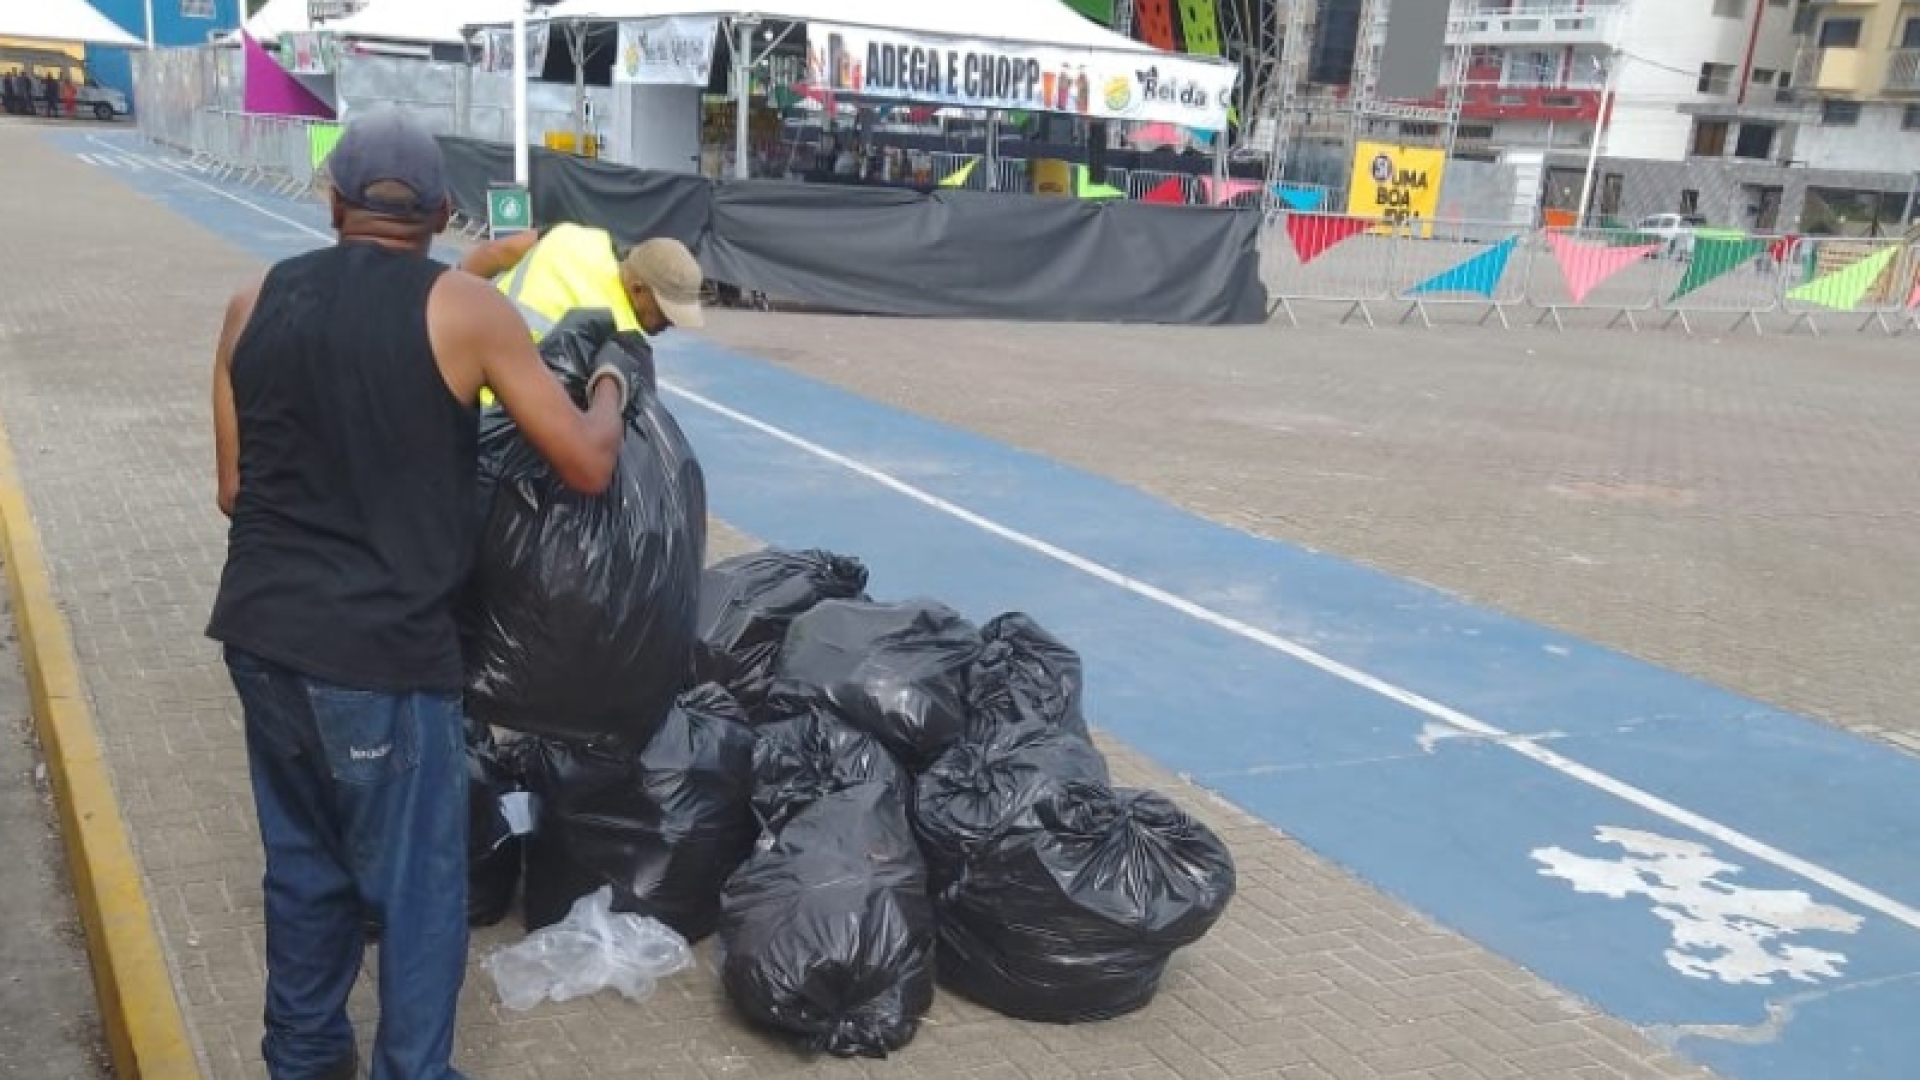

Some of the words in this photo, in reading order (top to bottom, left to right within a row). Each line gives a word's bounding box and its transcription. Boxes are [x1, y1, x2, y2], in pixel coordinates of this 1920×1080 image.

[866, 41, 941, 94] ADEGA
[947, 50, 958, 96] E
[964, 52, 1040, 100] CHOPP
[1143, 78, 1177, 101] Rei
